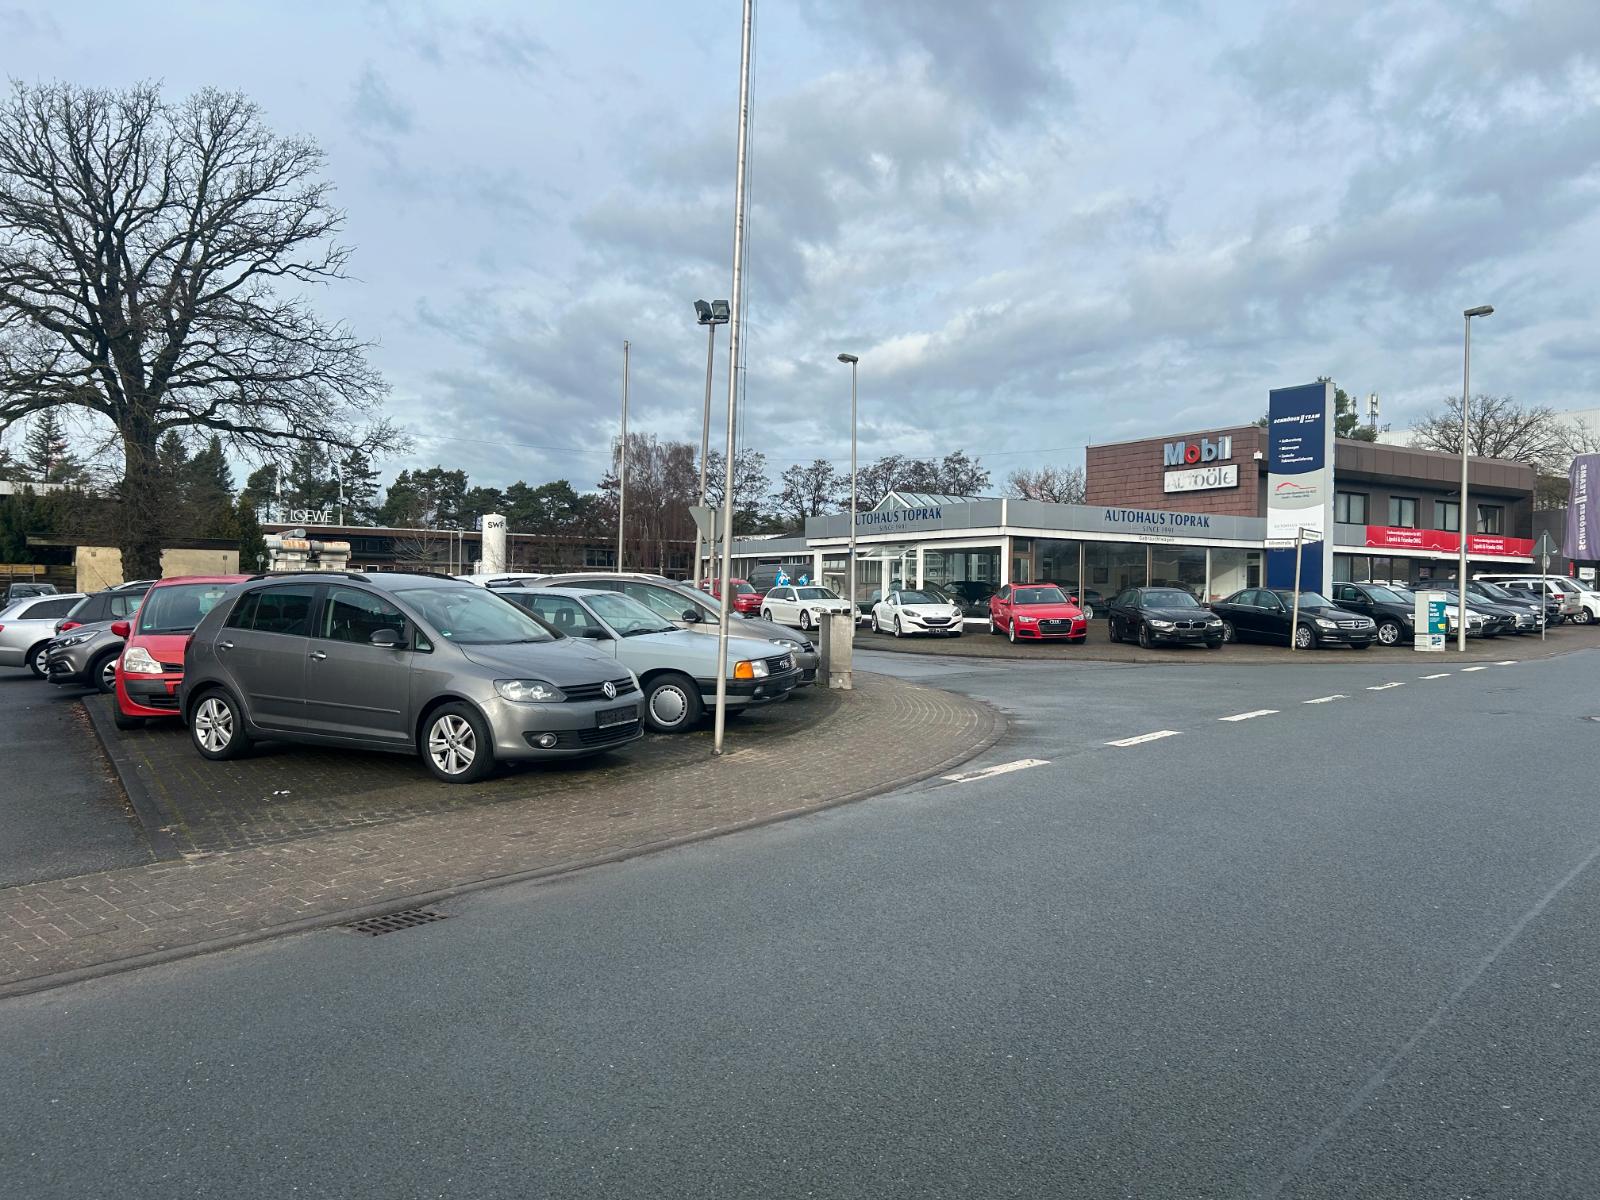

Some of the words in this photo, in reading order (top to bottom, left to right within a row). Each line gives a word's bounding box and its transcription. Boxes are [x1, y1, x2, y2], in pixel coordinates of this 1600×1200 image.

[1164, 436, 1232, 466] Mobil
[1167, 468, 1233, 489] Aoöle
[290, 509, 333, 522] LOEWE
[850, 510, 899, 526] UTOHAUS
[902, 507, 942, 521] TOPRAK
[1104, 509, 1165, 525] AUTOHAUS
[1169, 513, 1210, 528] TOPRAK
[1142, 525, 1159, 533] SINCE
